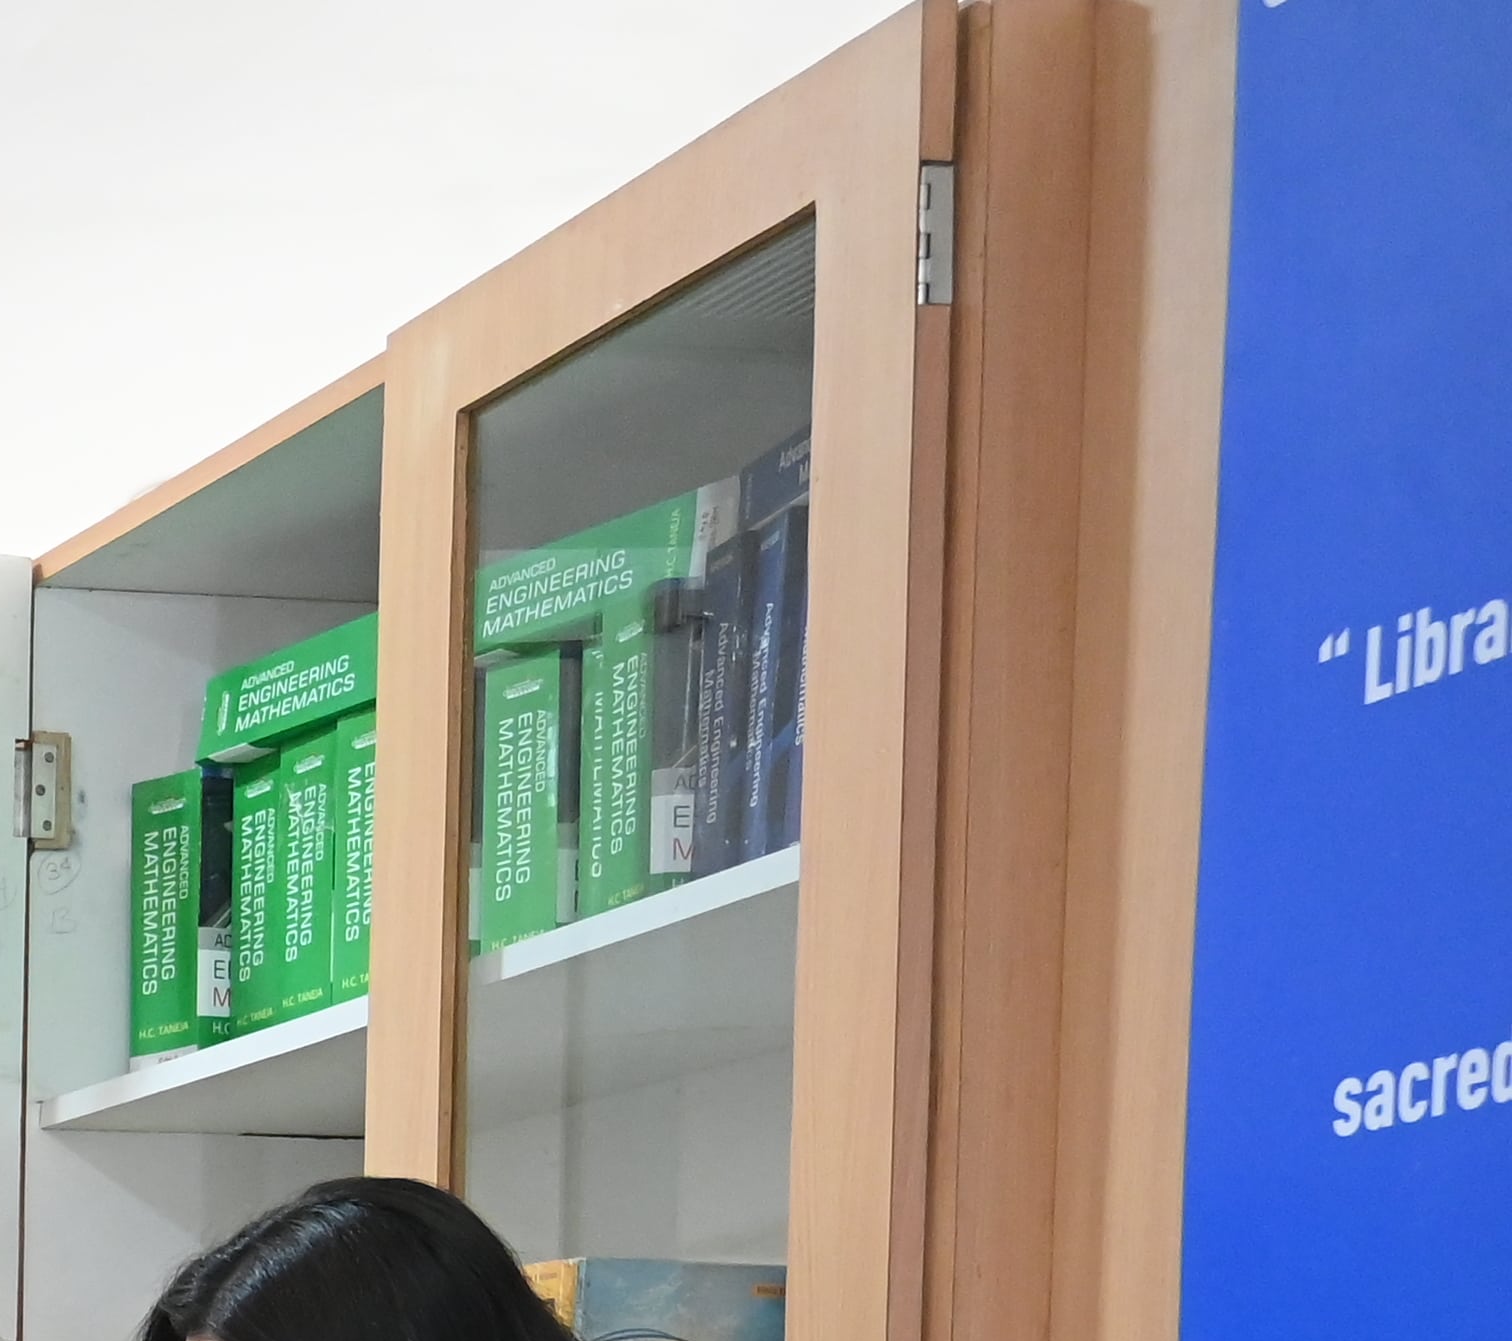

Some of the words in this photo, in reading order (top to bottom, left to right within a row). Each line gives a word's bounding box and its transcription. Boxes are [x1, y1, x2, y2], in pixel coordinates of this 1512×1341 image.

[482, 569, 633, 639] MATHEMATICS
[486, 550, 626, 615] ENGINEERING
[489, 557, 556, 592] ADVANCED
[238, 655, 350, 712] ENGINEERING
[241, 660, 295, 691] ADVANCED
[714, 622, 729, 712] Advanced
[758, 601, 774, 693] Advanced
[235, 673, 356, 733] MATHEMATICS
[624, 654, 639, 836] ENGINEERING
[534, 709, 546, 793] ADVANCED
[610, 662, 626, 856] MATHEMATICS
[706, 715, 724, 824] Engineering
[315, 783, 327, 862] ADVANCED
[495, 717, 515, 902] MATHEMATICS
[516, 711, 533, 884] ENGINEERING
[179, 825, 190, 900] ADVANCED
[252, 809, 266, 967] ENGINEERING
[266, 808, 276, 884] ADVANCED
[285, 791, 301, 963] MATHEMATICS
[300, 785, 316, 947] ENGINEERING
[345, 767, 362, 942] MATHEMATICS
[142, 831, 159, 996] MATHEMATICS
[161, 826, 177, 981] ENGINEERING
[239, 815, 253, 983] MATHEMATICS
[158, 1021, 189, 1038] TANEJA
[297, 988, 323, 1006] TANEJA
